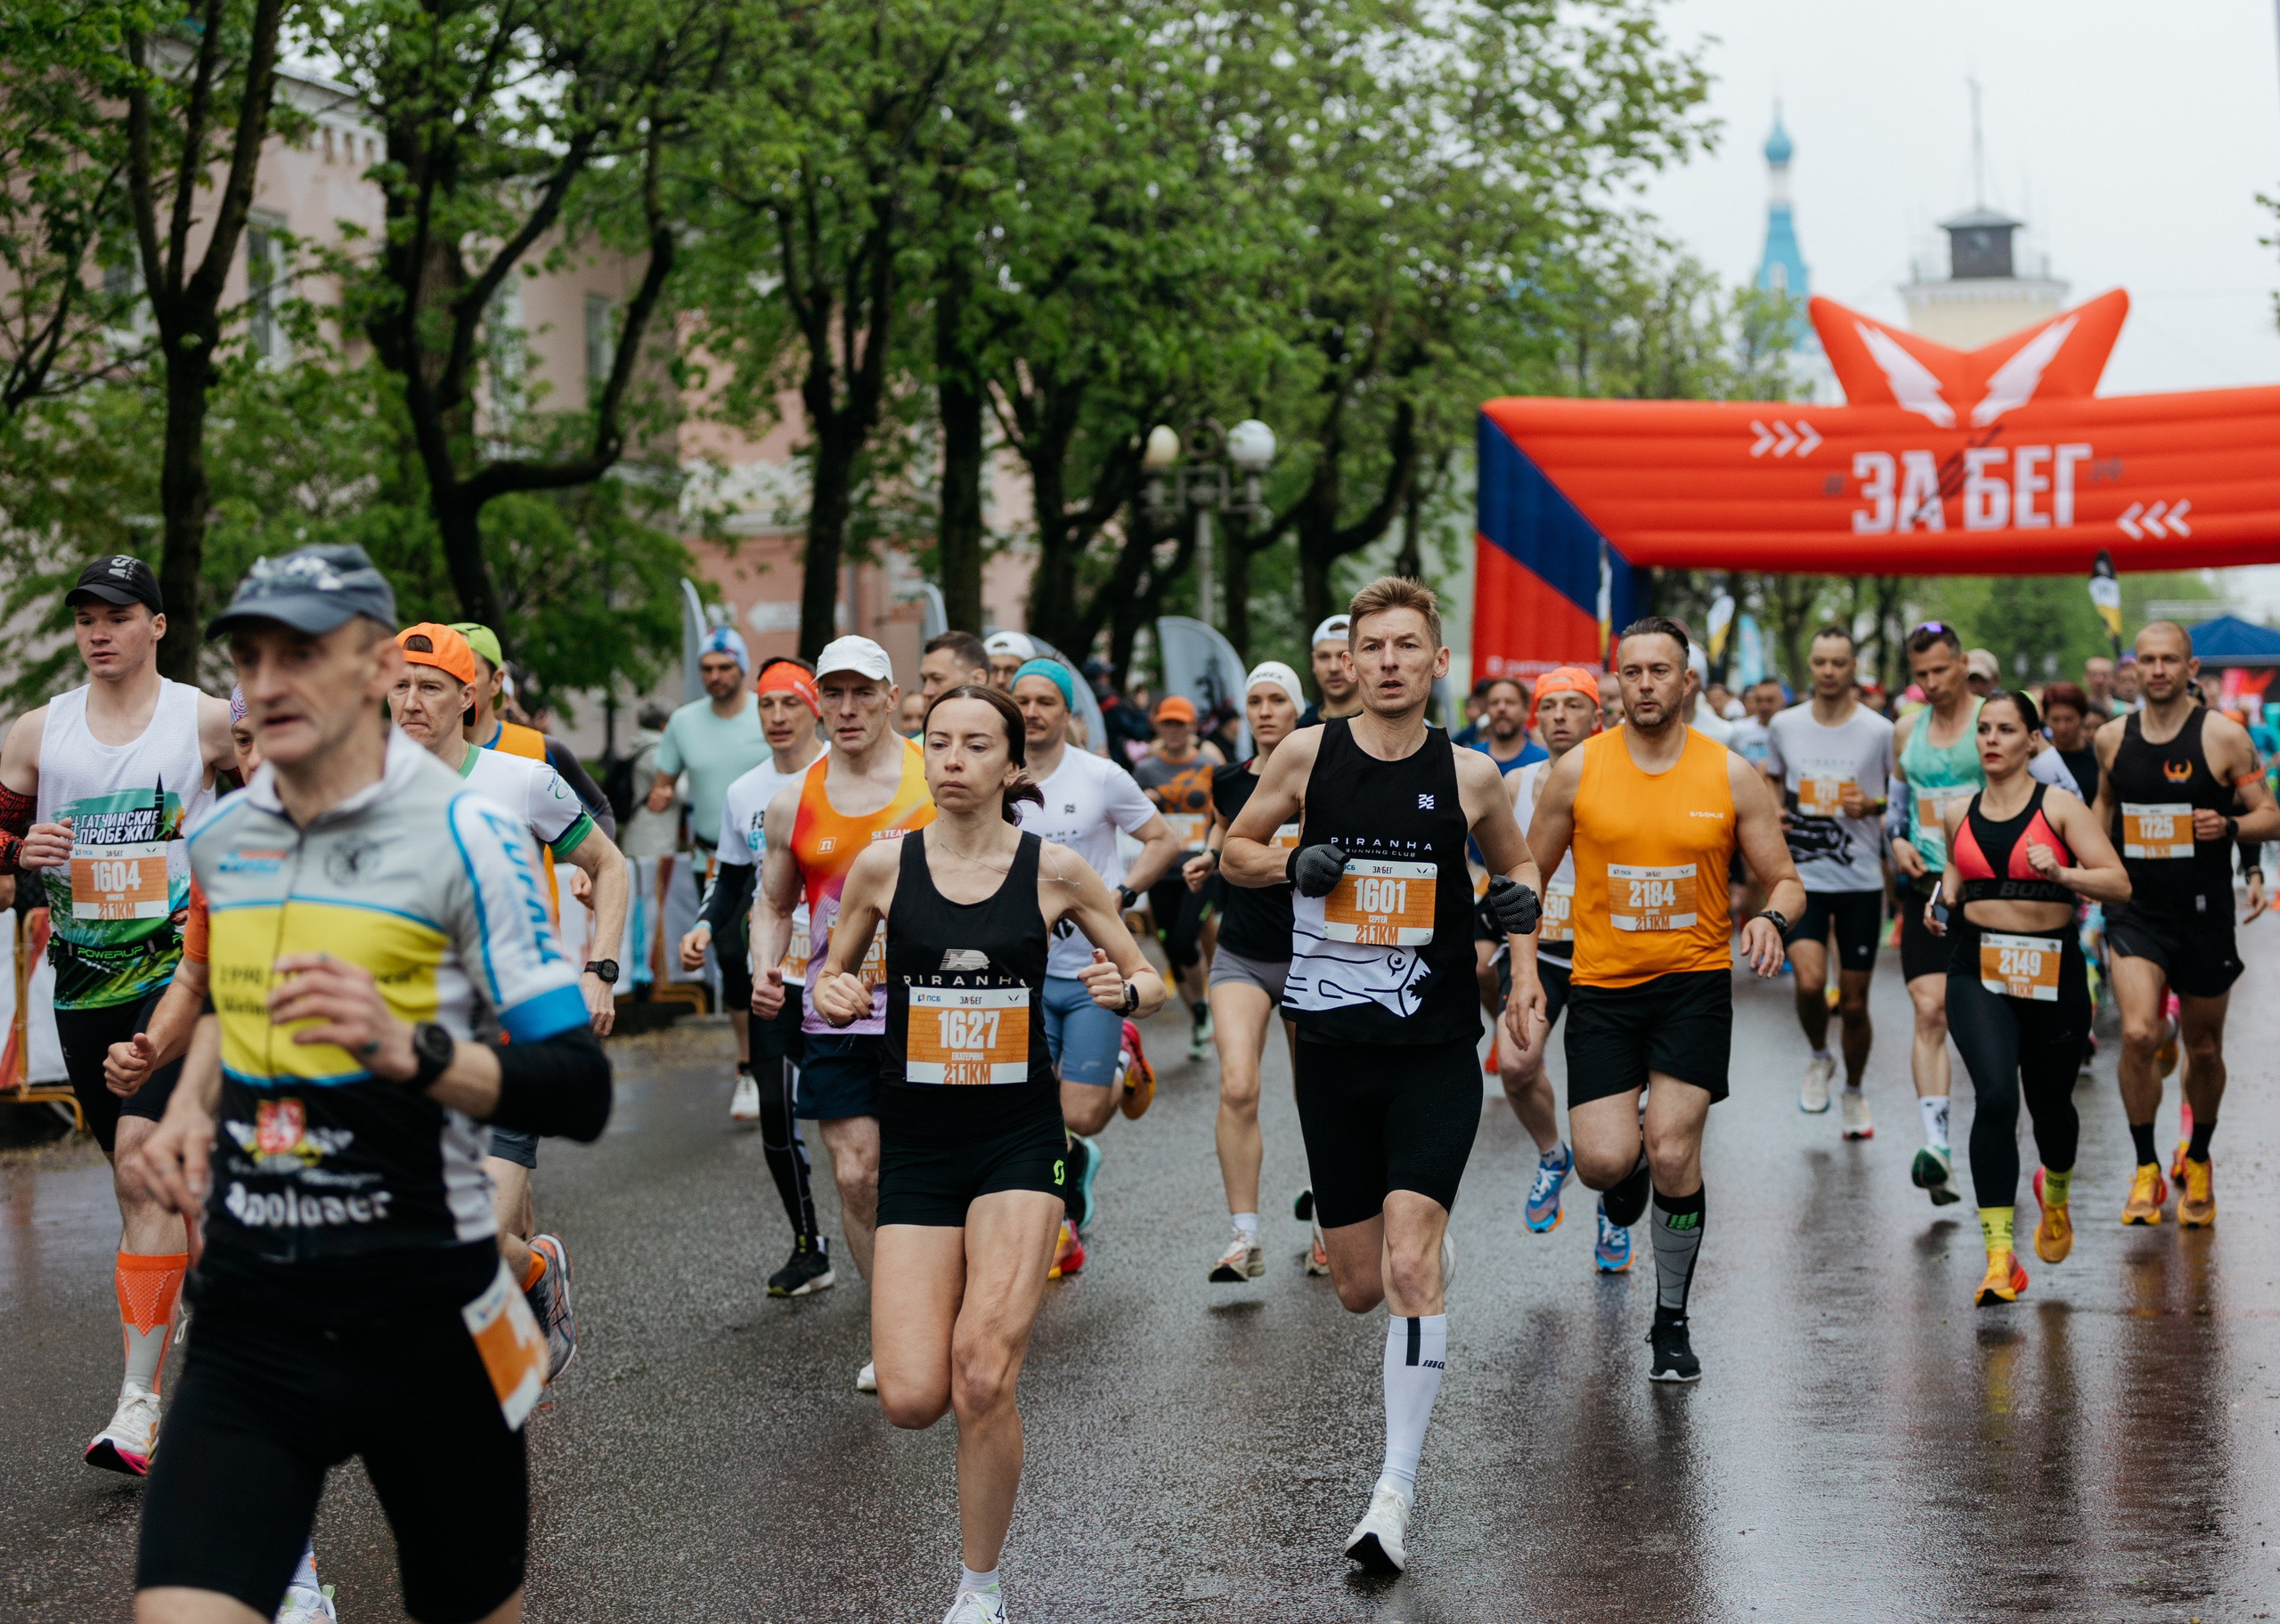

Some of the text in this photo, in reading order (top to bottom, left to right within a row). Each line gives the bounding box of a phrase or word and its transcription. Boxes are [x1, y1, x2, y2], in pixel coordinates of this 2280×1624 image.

[79, 824, 156, 844] ПРОБЕЖКИ
[871, 828, 911, 840] SL TEAM
[2138, 816, 2175, 840] 1725
[1331, 837, 1433, 851] PIRANHA
[1345, 848, 1388, 856] RUNNING
[91, 860, 142, 892] 1604
[1354, 877, 1406, 914] 1601
[1628, 881, 1676, 907] 2184
[1368, 914, 1388, 924] СЕРГЕЙ
[77, 945, 144, 959] POWERUP
[1999, 949, 2041, 978] 2149
[938, 1010, 1000, 1049] 1627
[951, 1052, 984, 1061] ЕКАТЕРИНА
